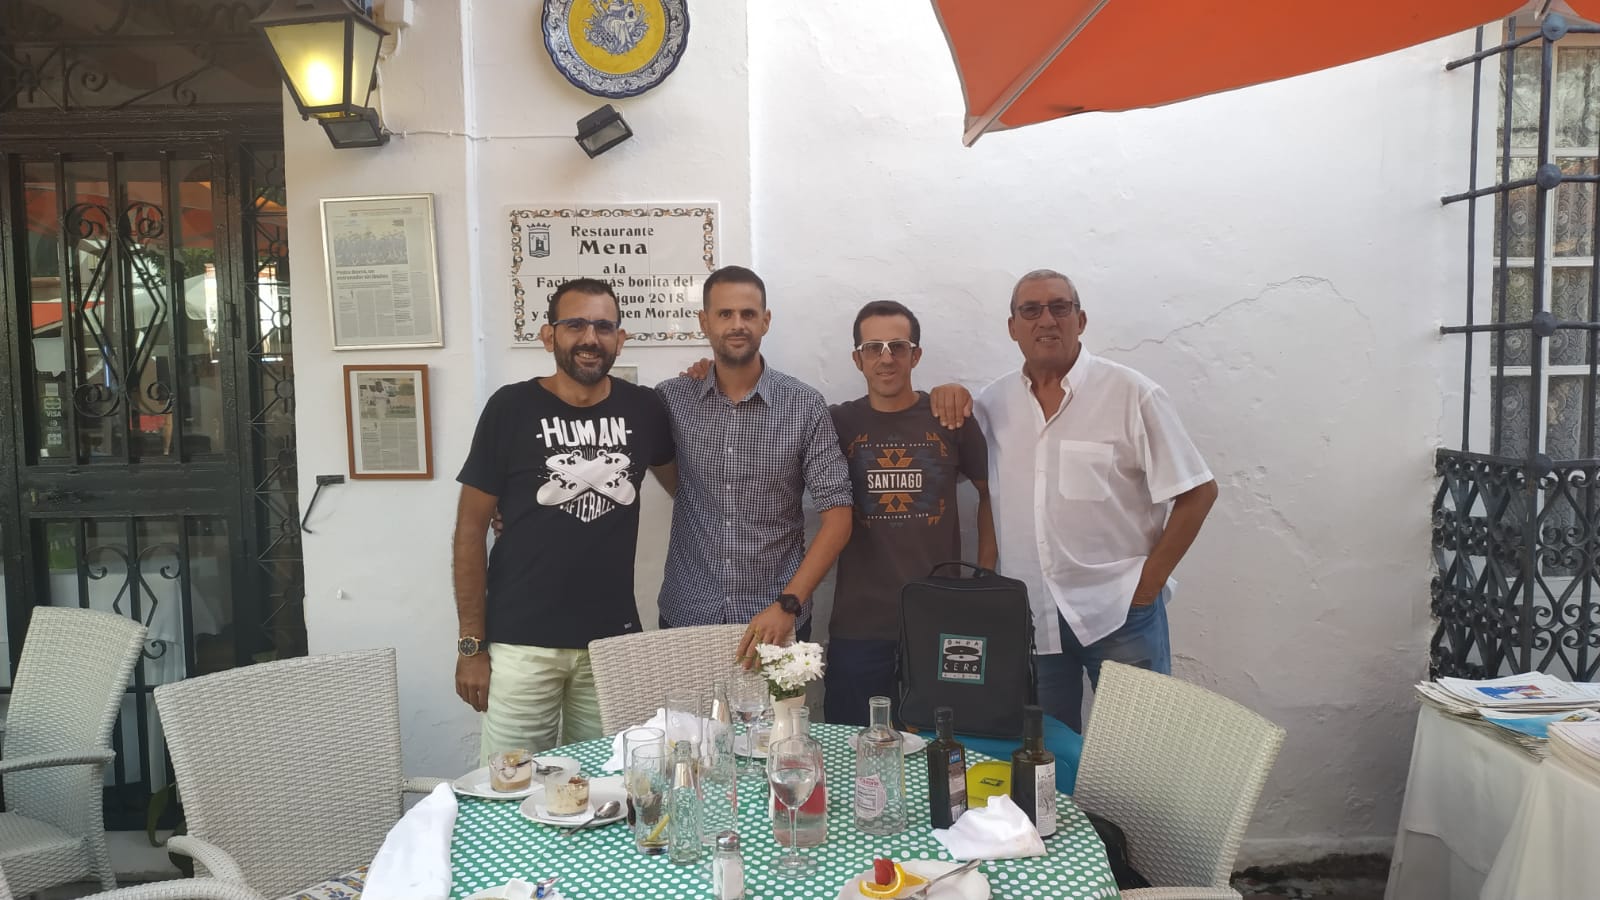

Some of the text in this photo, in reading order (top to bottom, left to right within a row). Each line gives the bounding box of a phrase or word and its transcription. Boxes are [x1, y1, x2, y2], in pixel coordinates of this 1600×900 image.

[571, 225, 654, 237] Restaurante
[579, 239, 648, 255] Mena
[603, 262, 626, 274] a la
[628, 275, 669, 287] bonita
[673, 275, 693, 287] del
[649, 292, 685, 303] 2018
[531, 311, 539, 321] y
[645, 307, 699, 319] Morales
[867, 473, 922, 489] SANTIAGO
[943, 662, 978, 672] CERO
